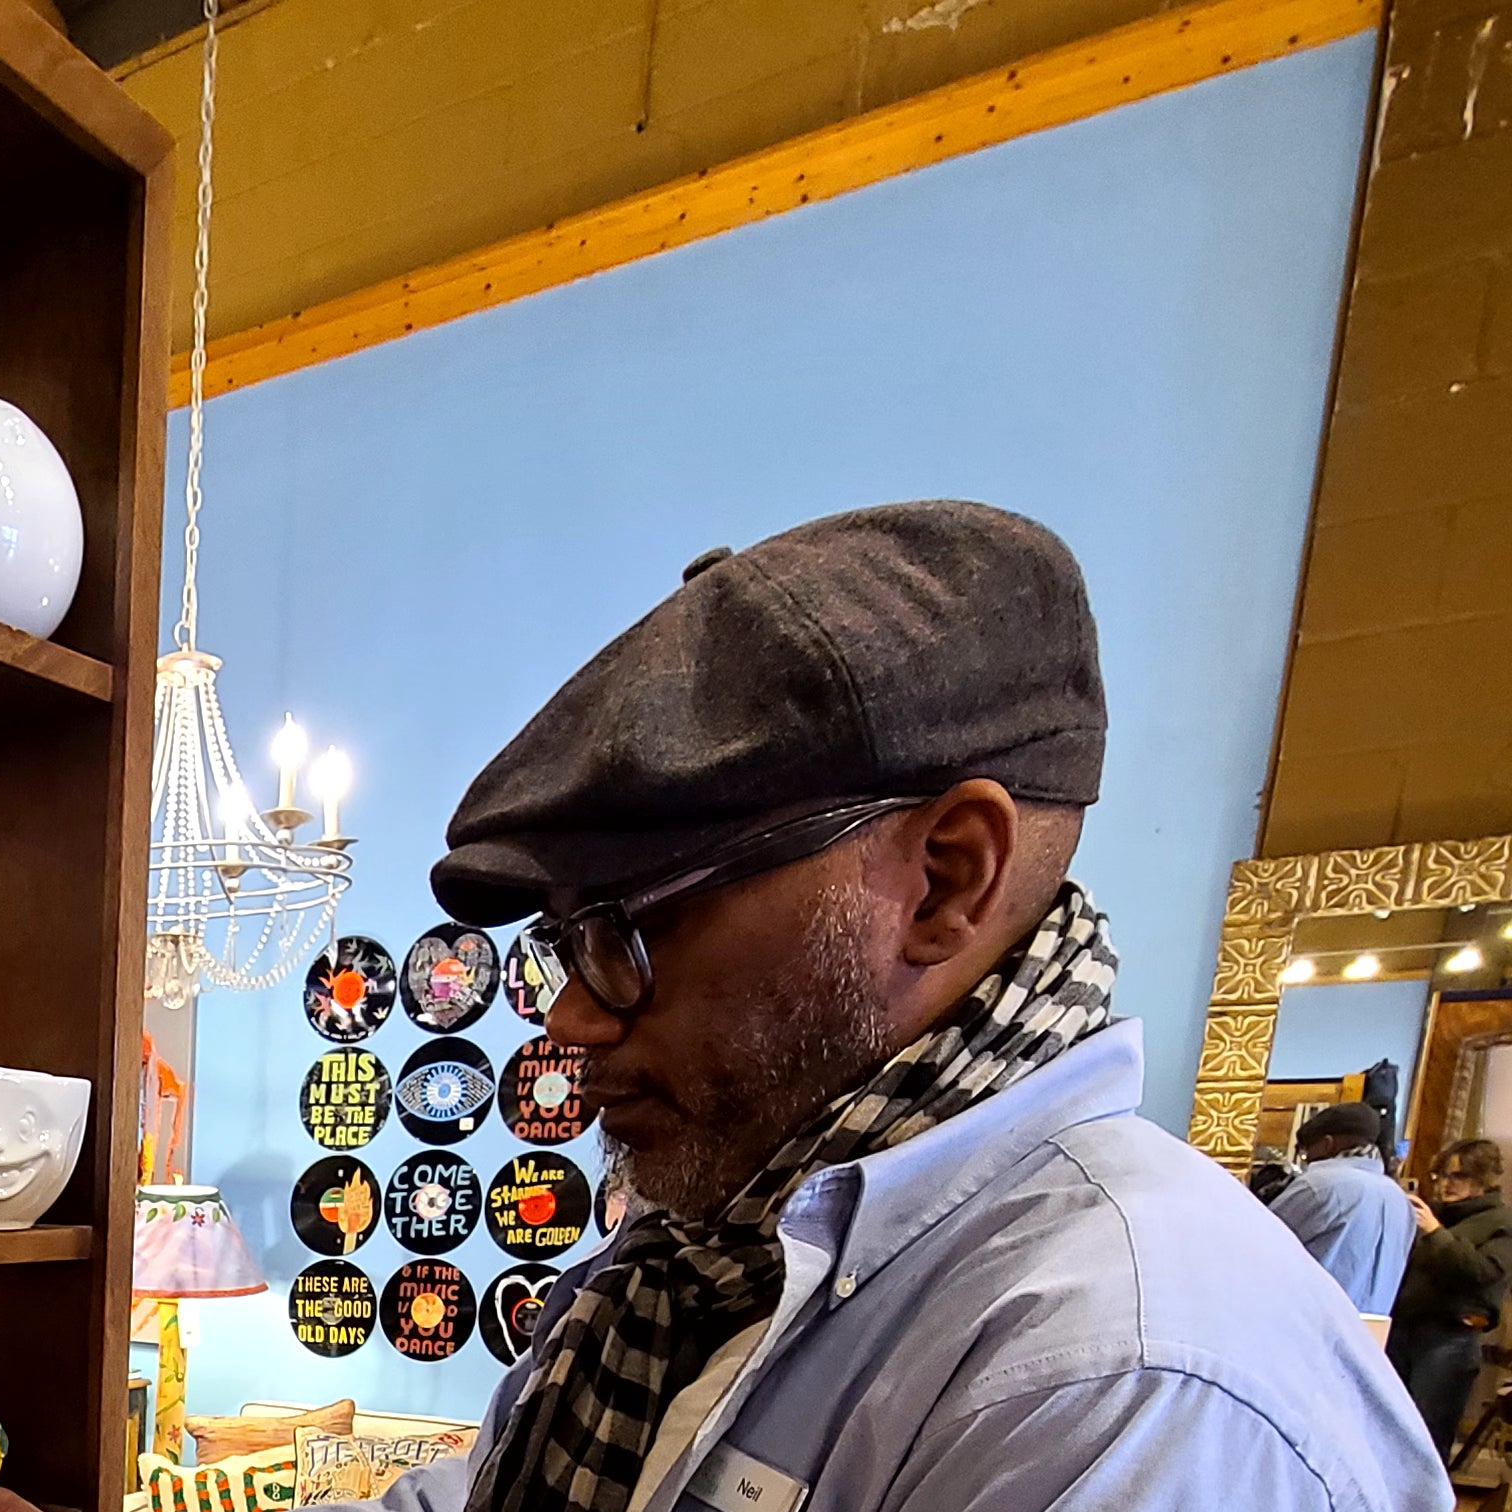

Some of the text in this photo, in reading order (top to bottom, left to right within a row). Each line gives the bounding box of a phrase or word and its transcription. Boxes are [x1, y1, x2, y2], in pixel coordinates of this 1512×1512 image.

[317, 1052, 376, 1082] THIS
[309, 1083, 380, 1104] MUST
[310, 1105, 375, 1124] BE THE
[519, 1099, 580, 1119] YOU
[313, 1125, 371, 1146] PLACE
[514, 1121, 582, 1139] DANCE
[393, 1164, 473, 1189] COME
[541, 1169, 565, 1181] ARE
[392, 1214, 468, 1238] THER
[495, 1210, 516, 1227] WE
[506, 1226, 581, 1246] ARE GOLDEN
[416, 1264, 429, 1279] IF
[434, 1266, 461, 1281] THE
[297, 1276, 368, 1293] THESE ARE
[295, 1299, 372, 1319] THE GOOD
[298, 1324, 366, 1345] OLD DAYS
[400, 1318, 454, 1339] YOU
[395, 1337, 455, 1356] DANCE
[736, 1477, 763, 1503] Neil
